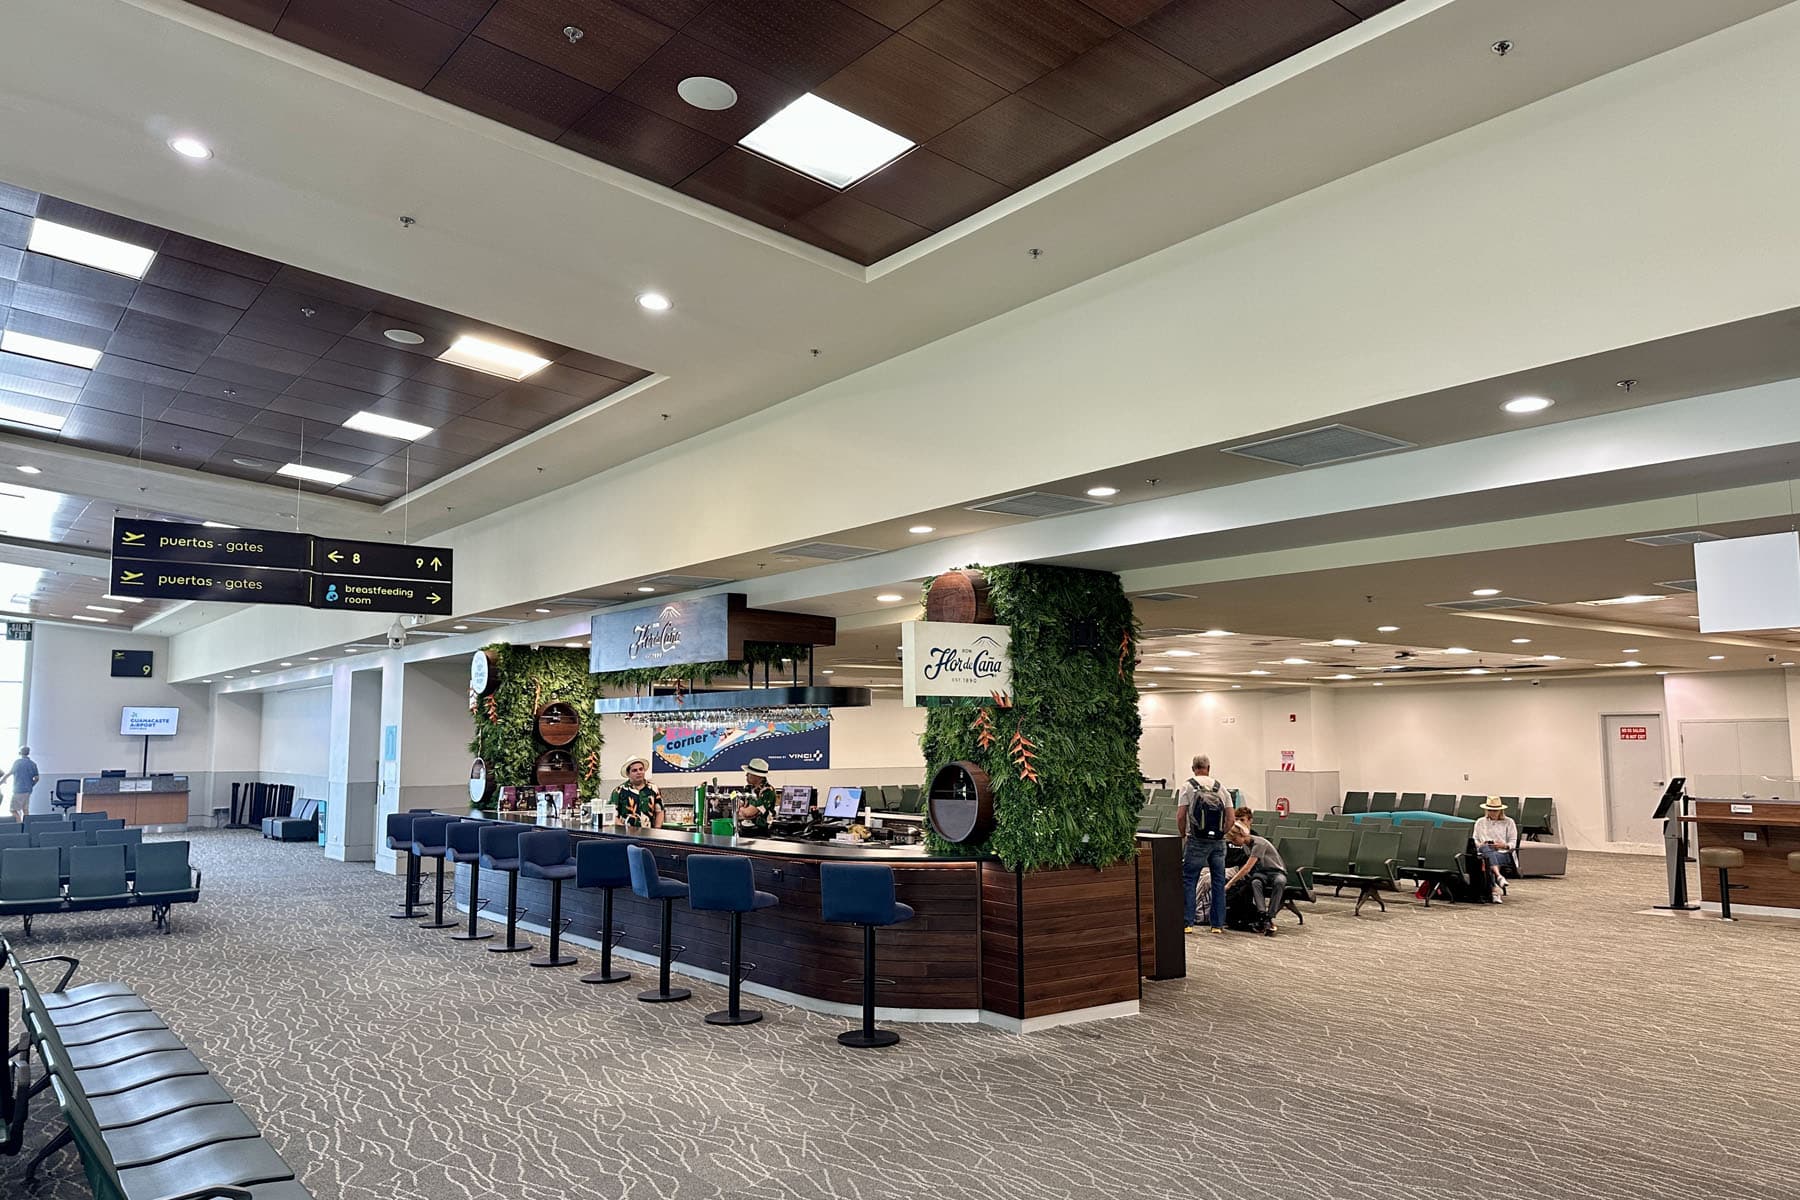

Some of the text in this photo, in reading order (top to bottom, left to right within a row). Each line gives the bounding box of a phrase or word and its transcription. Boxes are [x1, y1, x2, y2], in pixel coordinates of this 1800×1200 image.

[159, 536, 214, 549] puertas
[225, 541, 264, 553] gates
[352, 553, 361, 564] 8
[415, 558, 424, 569] 9
[158, 575, 213, 587] puertas
[224, 579, 263, 590] gates
[345, 584, 414, 599] breastfeeding
[344, 596, 372, 605] room
[12, 623, 31, 632] SALIDA
[15, 631, 27, 640] EXIT
[924, 647, 963, 680] Flor
[973, 649, 1002, 678] Caña
[142, 664, 151, 675] 9
[666, 734, 708, 751] corner
